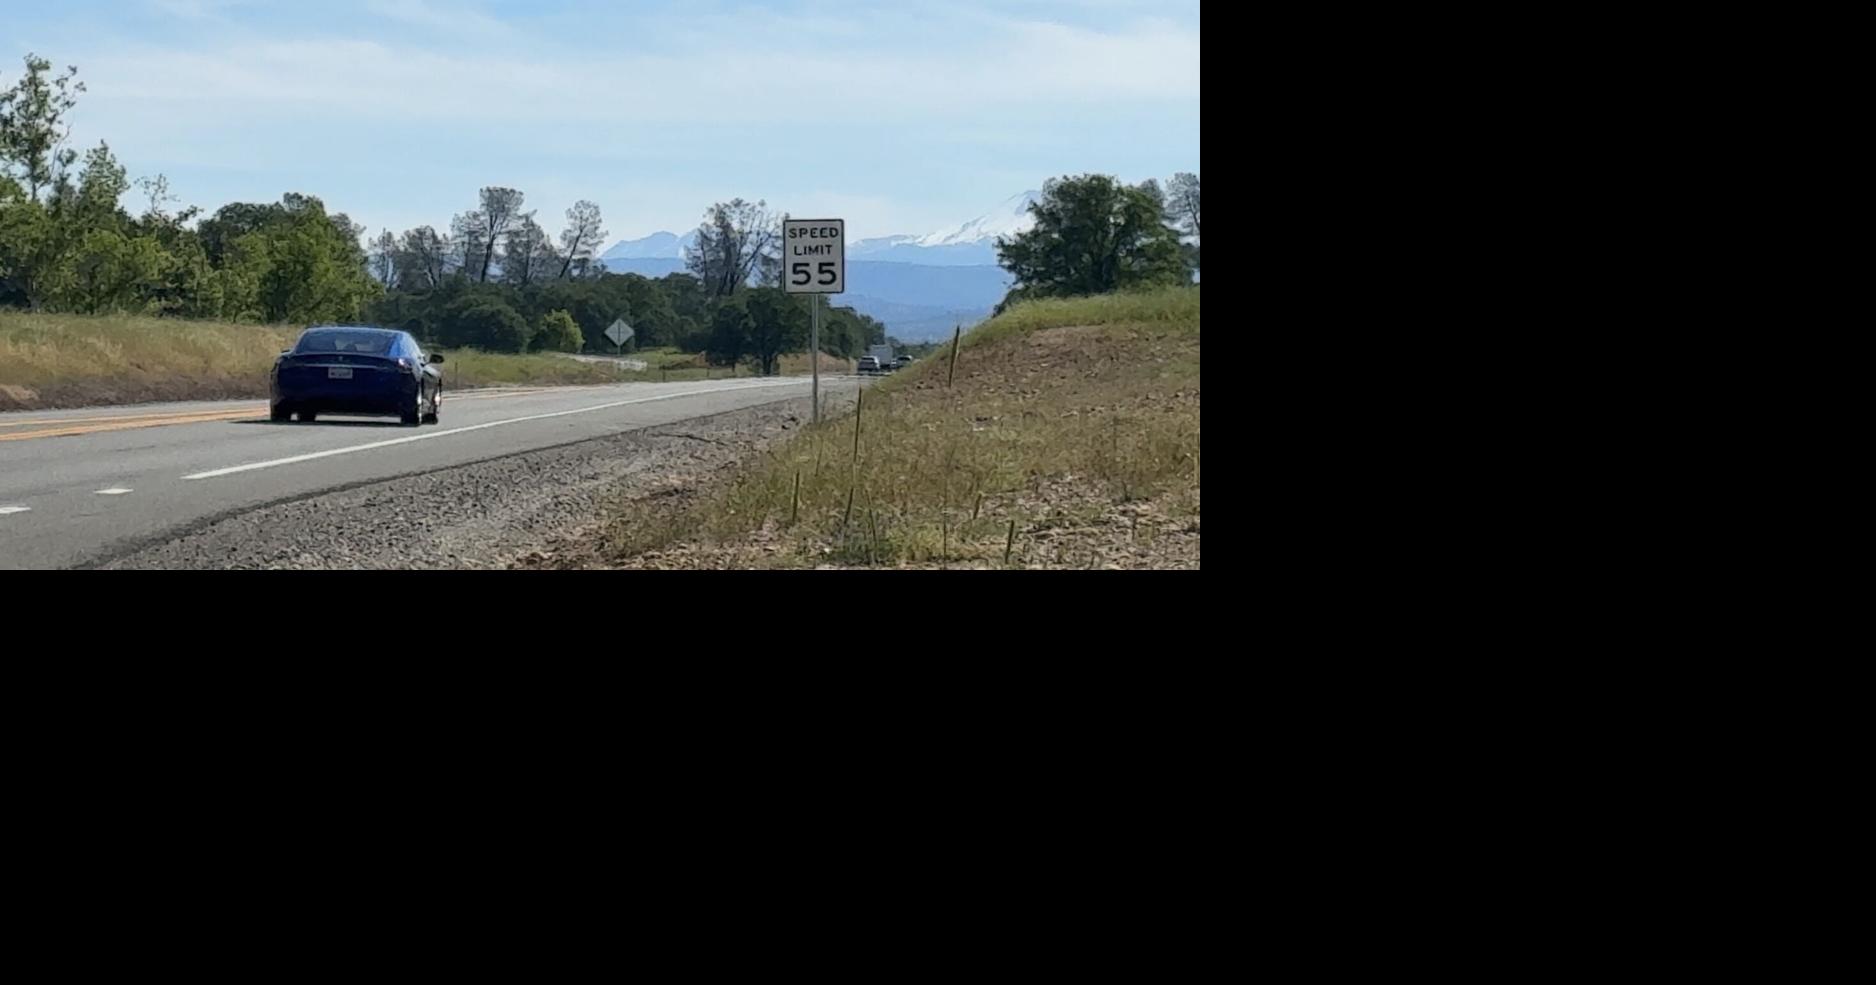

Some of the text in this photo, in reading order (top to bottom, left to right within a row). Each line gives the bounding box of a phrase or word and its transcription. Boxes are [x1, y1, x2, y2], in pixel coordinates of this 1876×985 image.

[788, 227, 839, 239] SPEED
[793, 244, 833, 256] LIMIT
[791, 262, 837, 286] 55
